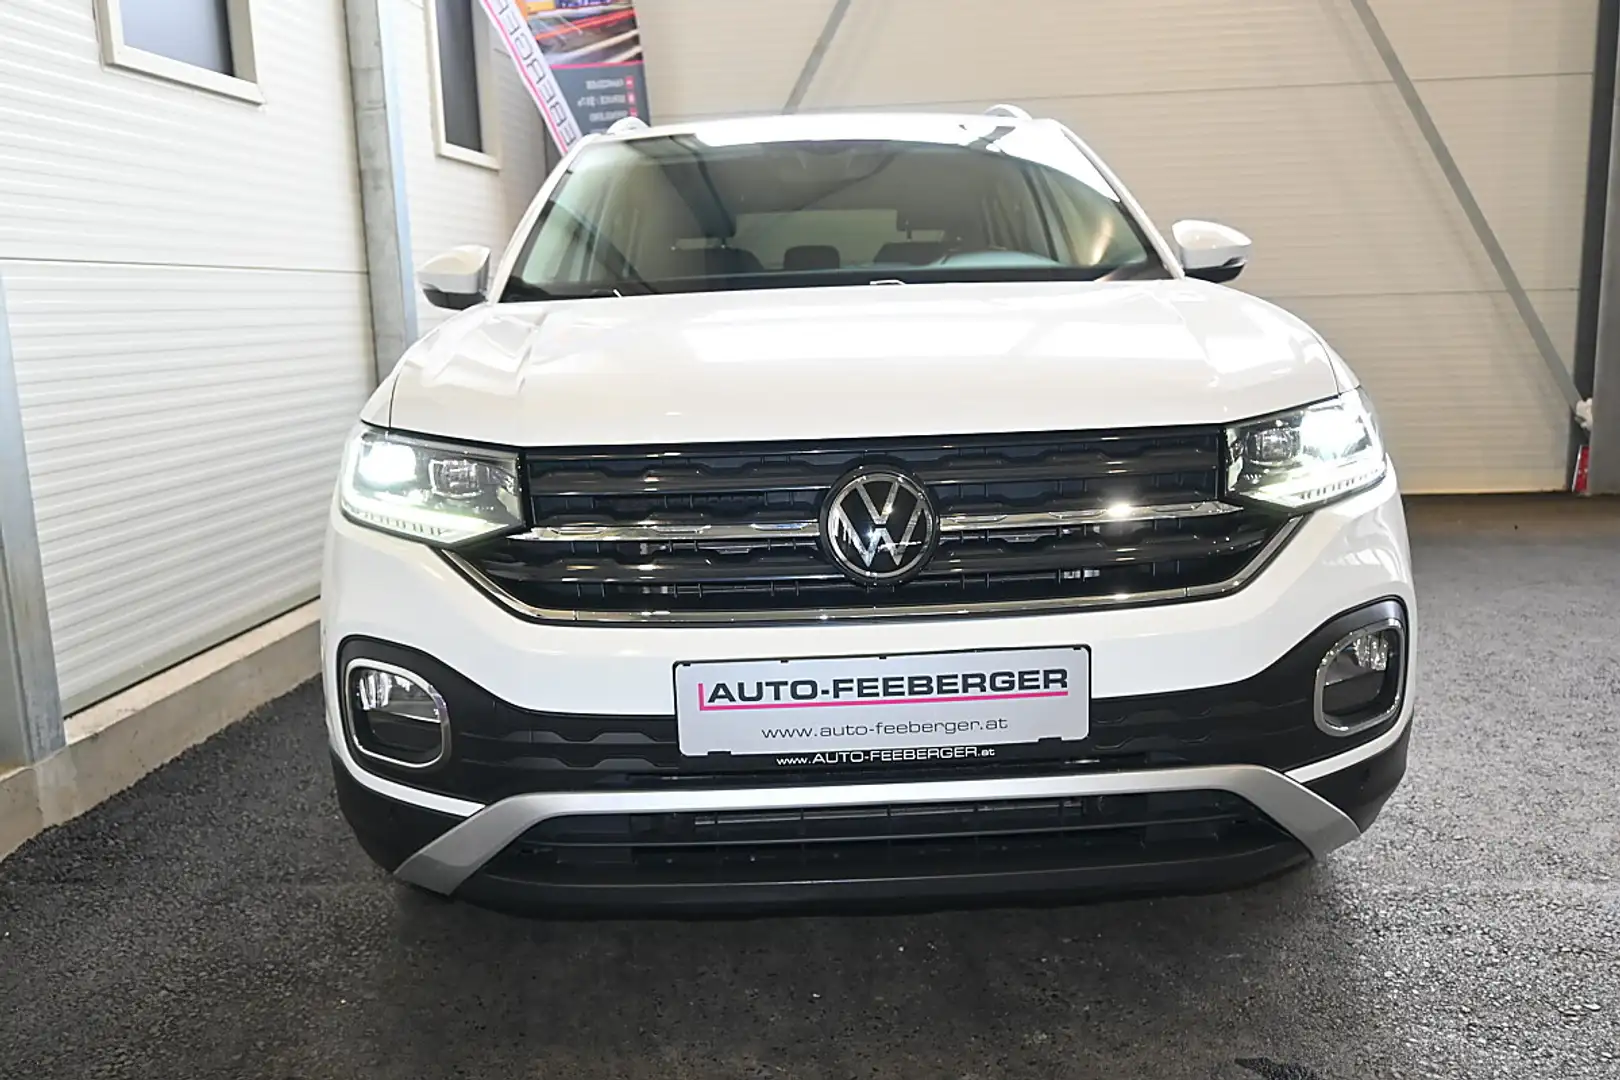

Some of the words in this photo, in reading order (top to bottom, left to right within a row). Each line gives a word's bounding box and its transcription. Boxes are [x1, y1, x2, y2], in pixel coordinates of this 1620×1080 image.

[834, 476, 928, 570] VW
[707, 668, 1069, 703] AUTO-FEEBERGER
[761, 716, 1009, 739] www.auto-feeberger.at
[776, 746, 996, 766] www.AUTO-FEEBERGER.at
